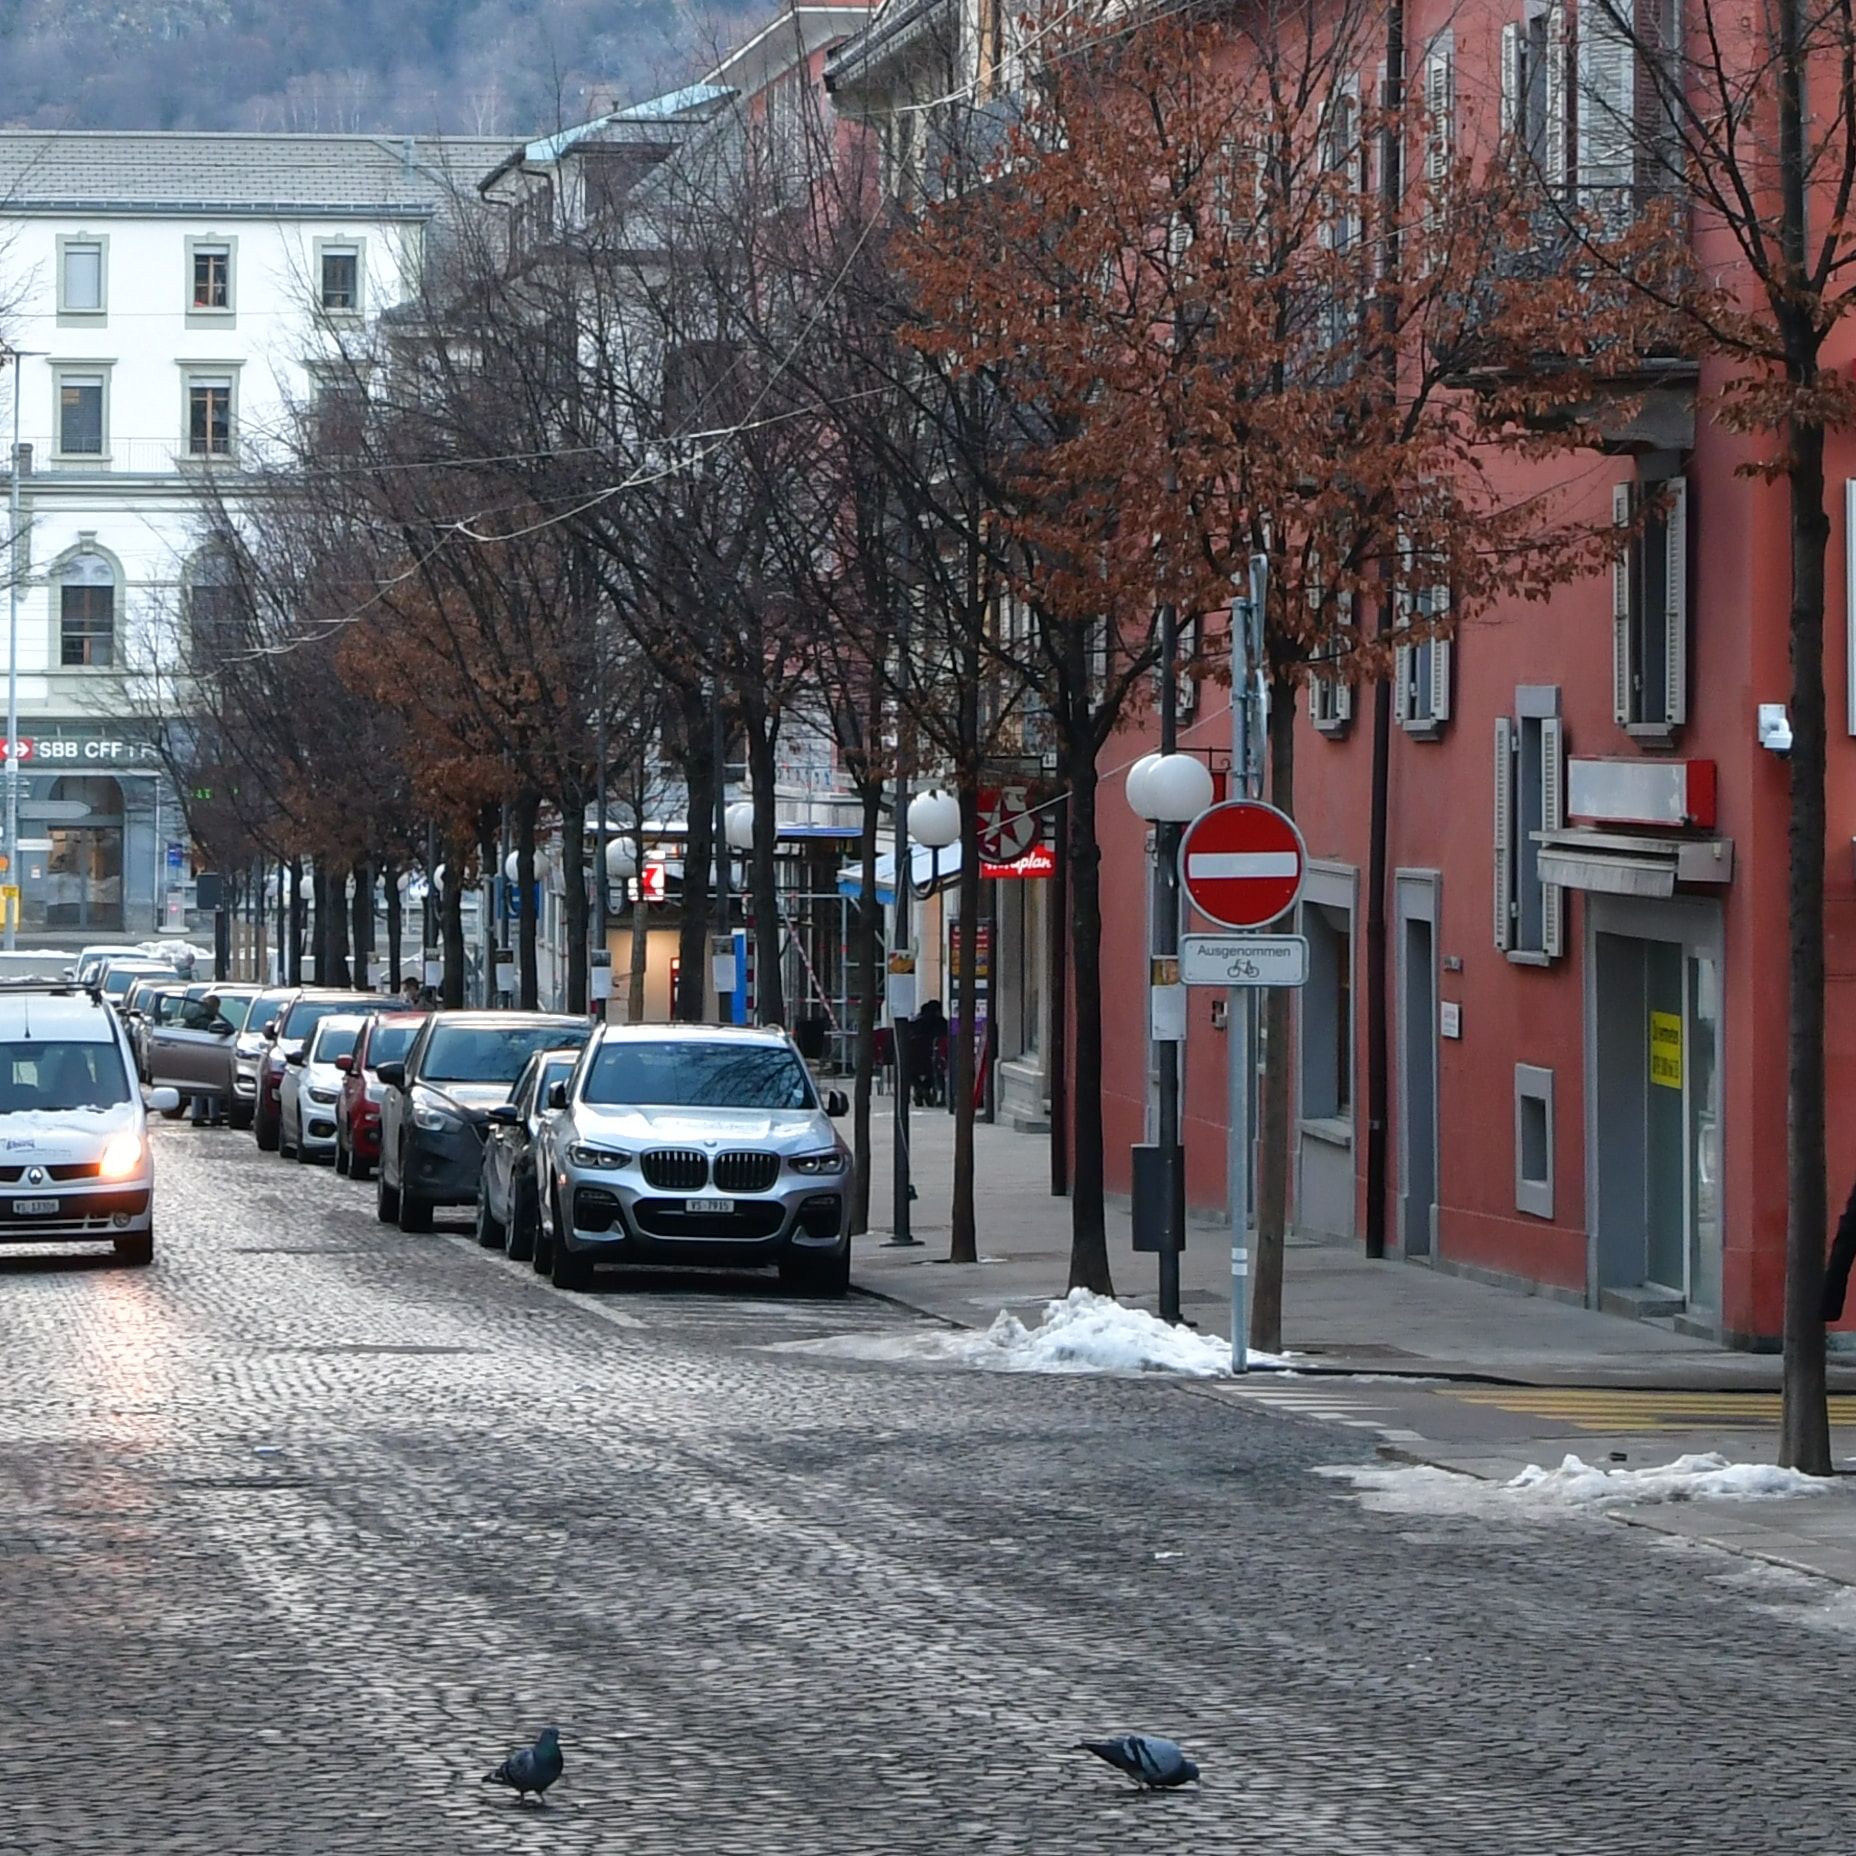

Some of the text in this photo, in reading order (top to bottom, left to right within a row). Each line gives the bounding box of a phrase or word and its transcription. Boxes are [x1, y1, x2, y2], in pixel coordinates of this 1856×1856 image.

[39, 741, 78, 758] SBB
[84, 741, 123, 758] CFF
[1197, 944, 1291, 959] Ausgenommen
